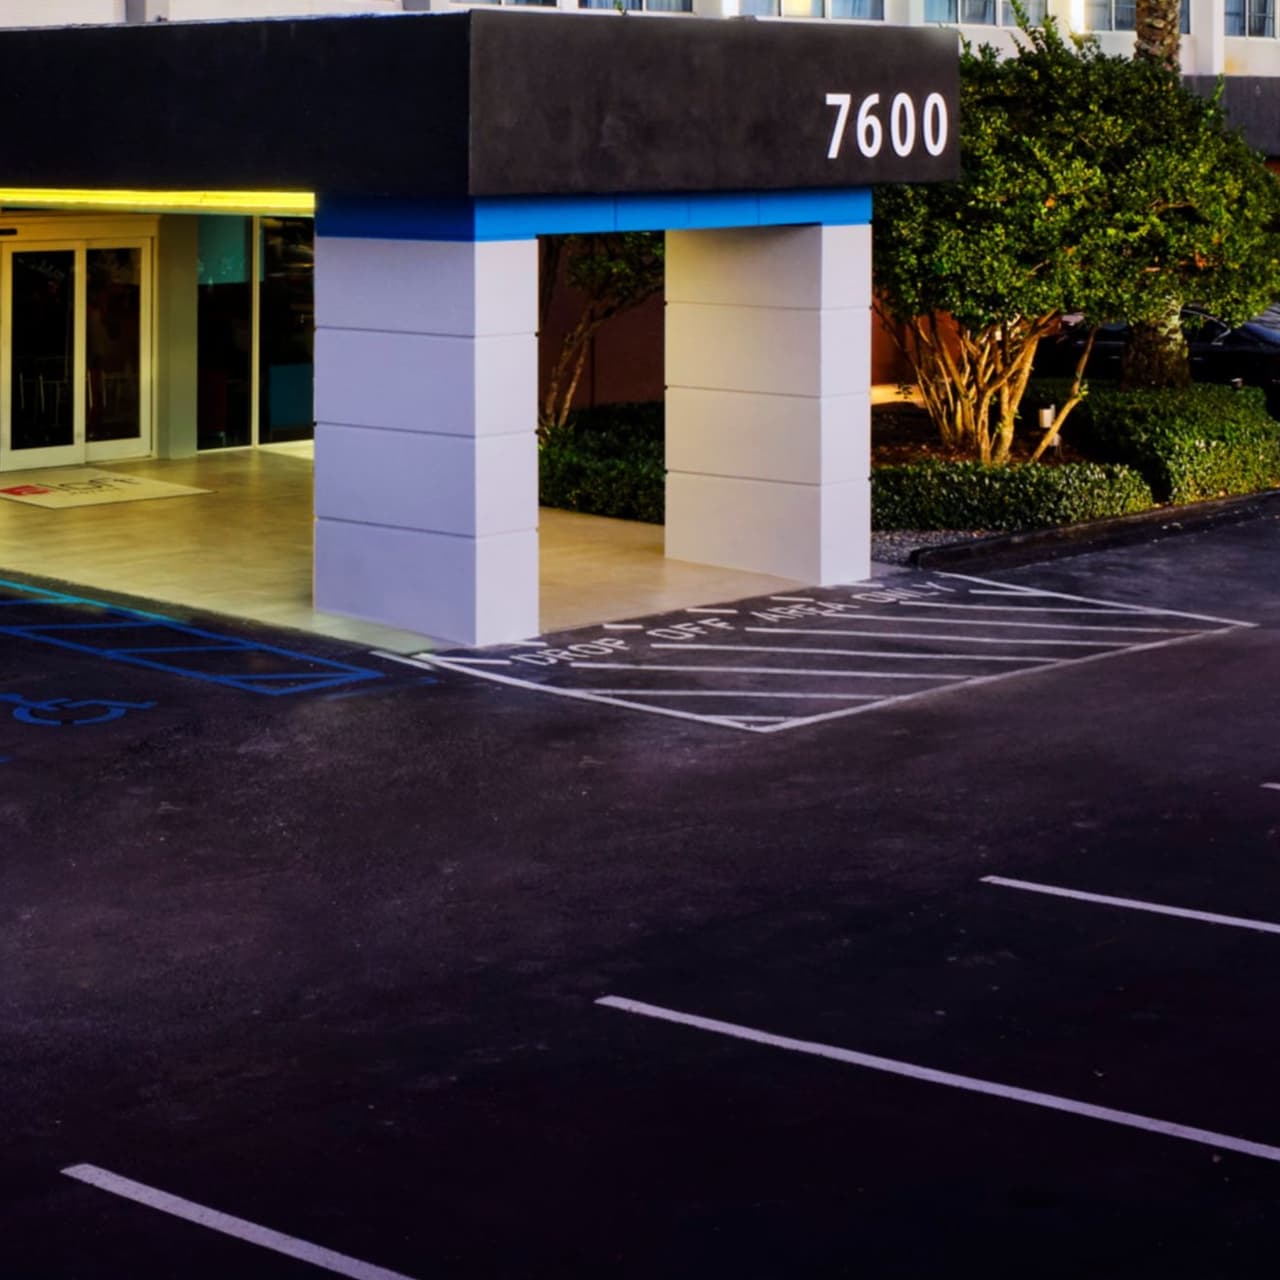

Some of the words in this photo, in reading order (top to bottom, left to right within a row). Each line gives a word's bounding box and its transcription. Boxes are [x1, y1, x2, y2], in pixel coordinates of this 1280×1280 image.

[825, 92, 948, 159] 7600
[508, 637, 630, 666] DROP
[646, 617, 737, 640] OFF
[750, 601, 858, 622] AREA
[851, 581, 956, 603] ONLY
